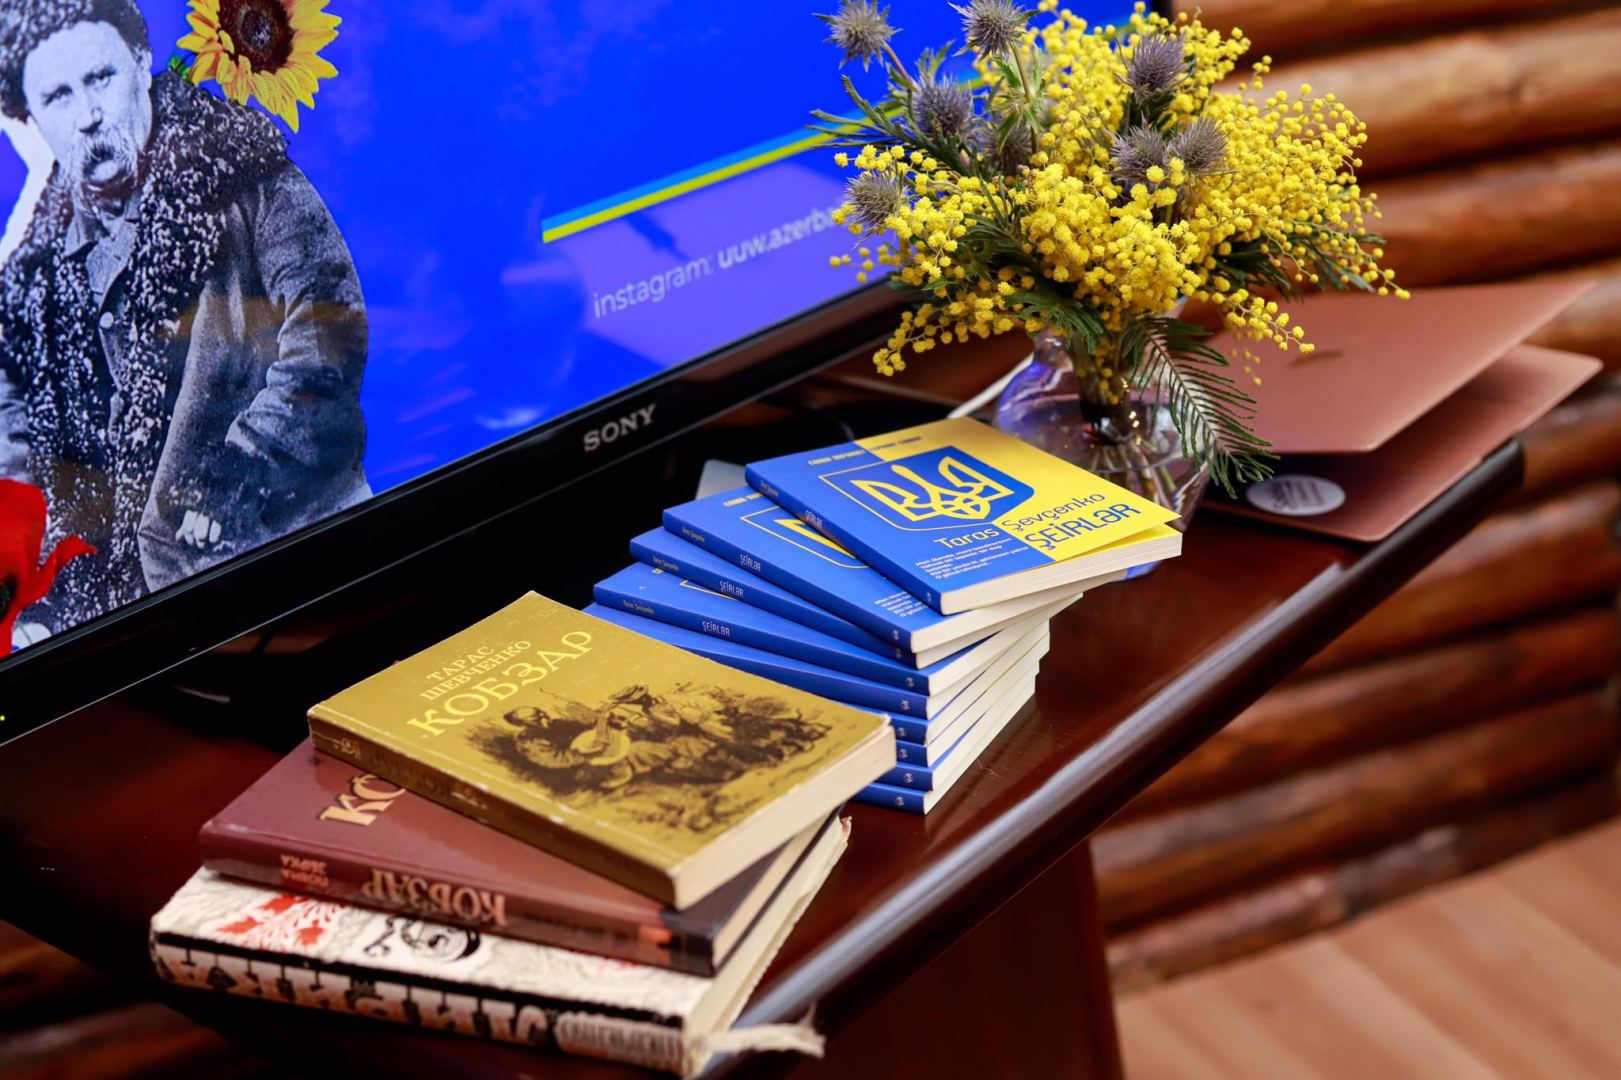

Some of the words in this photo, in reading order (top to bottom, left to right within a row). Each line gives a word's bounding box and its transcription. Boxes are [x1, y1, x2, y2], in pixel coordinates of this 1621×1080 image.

[583, 403, 656, 452] SONY
[933, 526, 1000, 549] Taras
[1001, 493, 1105, 532] Şevçenko
[406, 631, 593, 736] КОБЗАР
[420, 640, 532, 701] ШЕВЧЕНКО
[426, 646, 495, 682] ТАРАС
[362, 869, 506, 927] КОБЗАР
